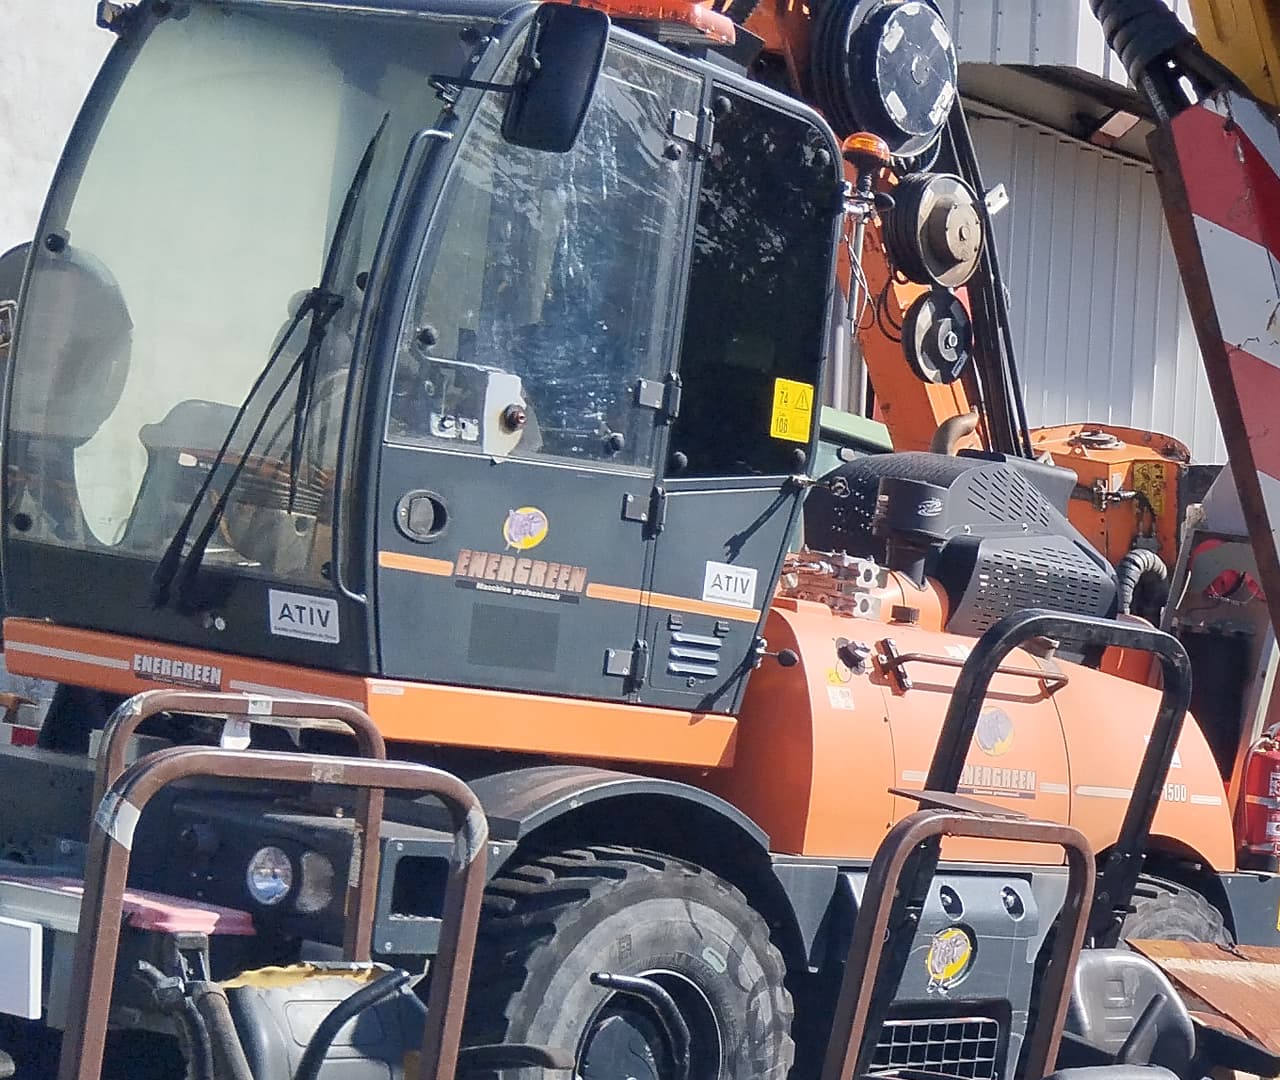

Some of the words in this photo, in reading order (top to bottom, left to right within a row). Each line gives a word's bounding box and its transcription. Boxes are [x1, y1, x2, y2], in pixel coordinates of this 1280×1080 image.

[454, 549, 588, 592] ENERGREEN
[710, 573, 750, 594] ATIV
[278, 602, 331, 628] ATIV
[133, 653, 222, 685] ENERGREEN
[960, 764, 1036, 791] NERGREEN
